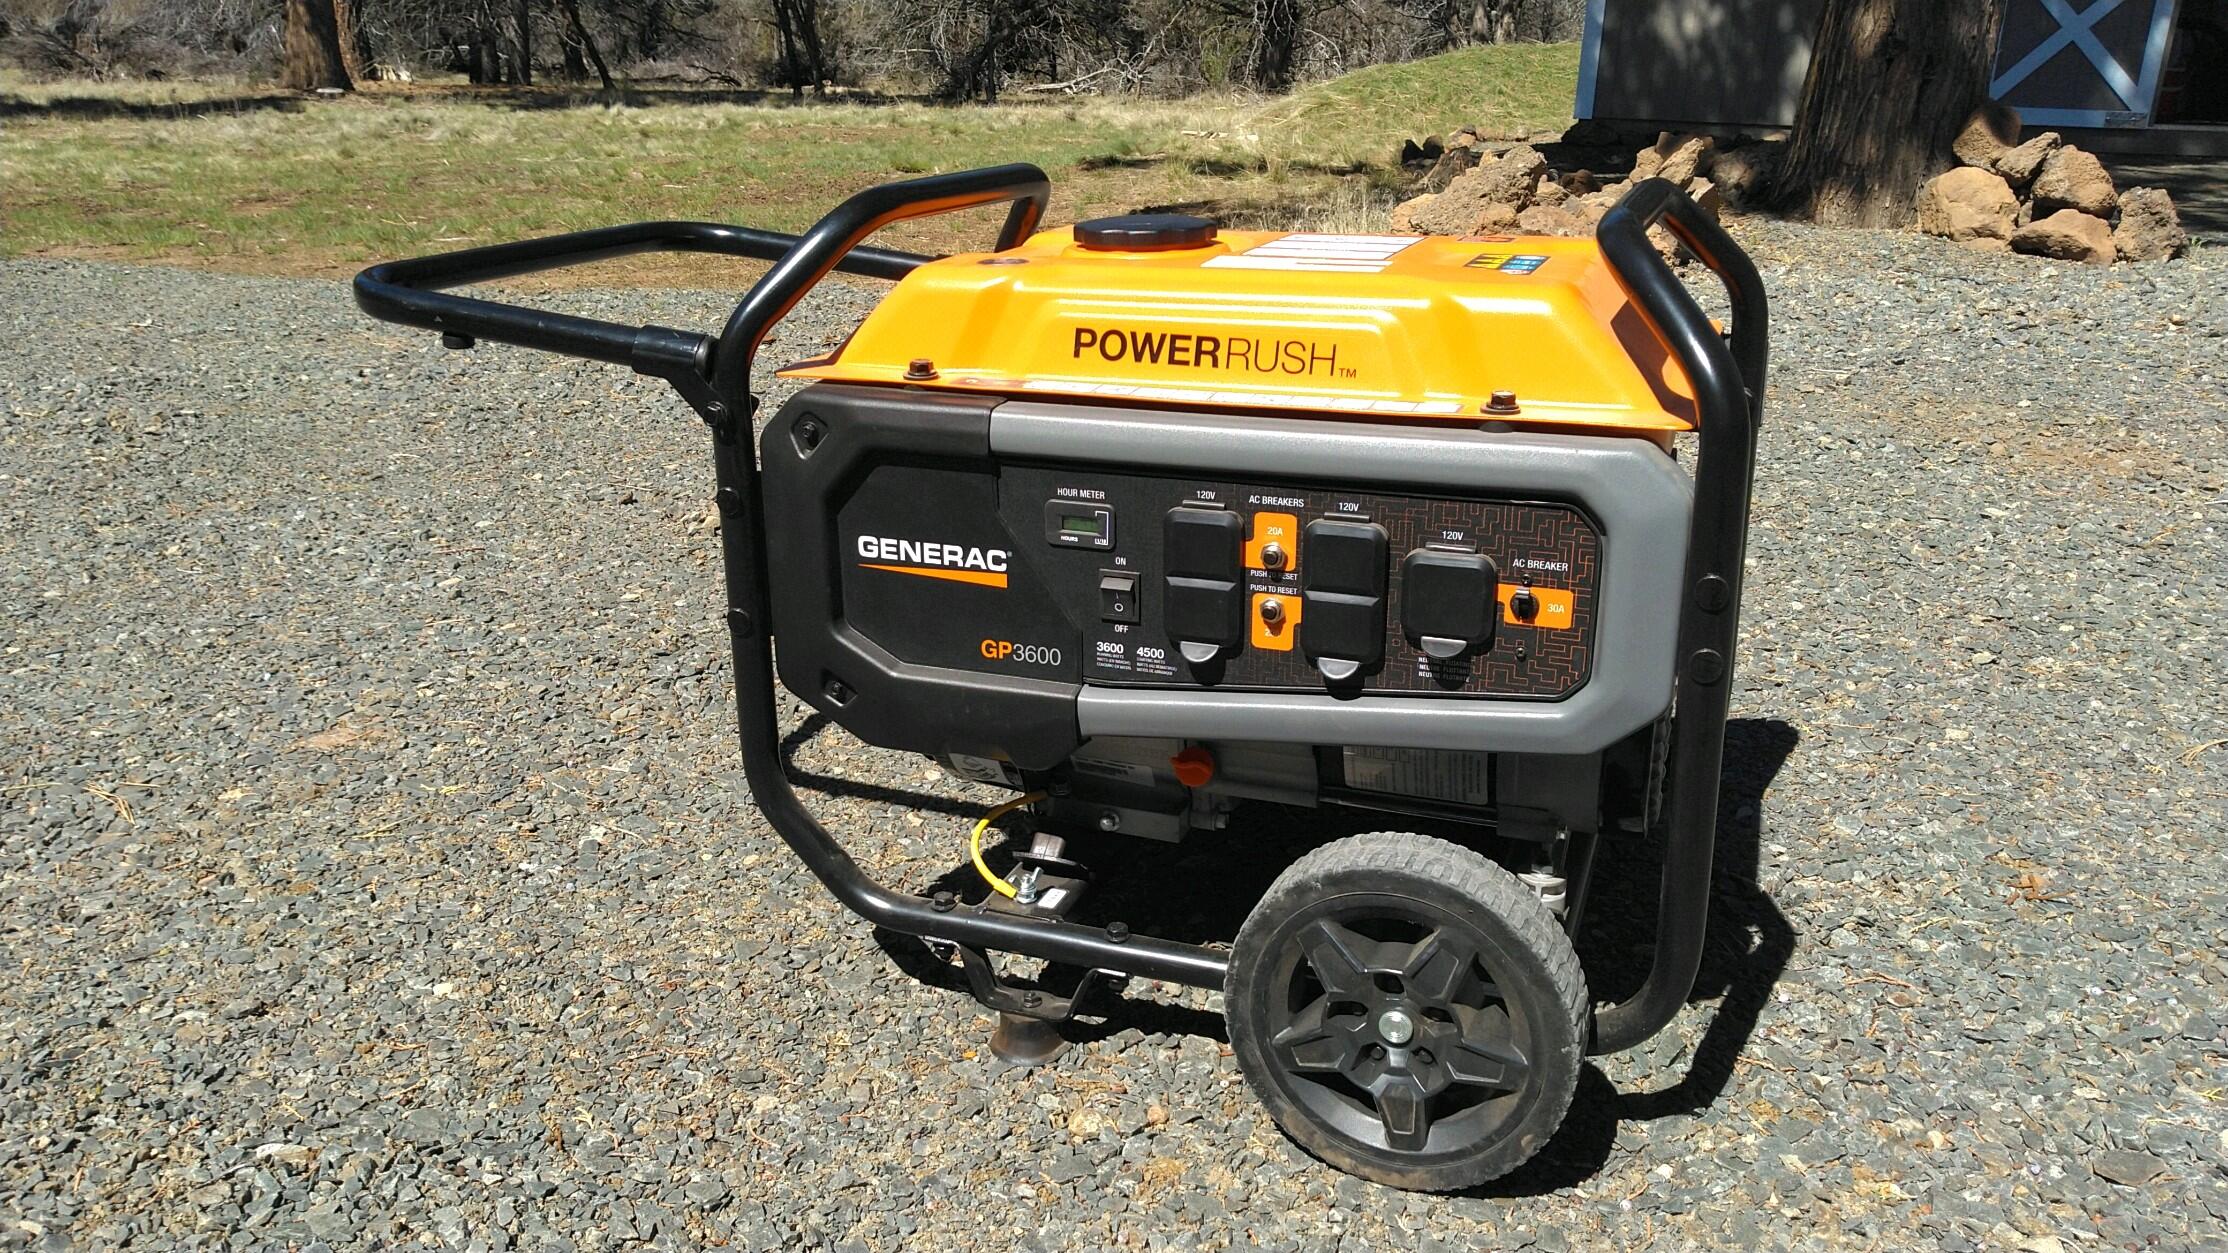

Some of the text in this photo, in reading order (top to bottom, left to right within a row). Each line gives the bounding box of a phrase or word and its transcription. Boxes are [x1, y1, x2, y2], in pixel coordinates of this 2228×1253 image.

[1057, 488, 1105, 500] HOUR METER
[1196, 490, 1216, 500] 120V
[1248, 495, 1305, 508] AC BREAKERS
[1338, 502, 1360, 512] 120V
[1267, 527, 1283, 537] 20A
[1442, 530, 1464, 541] 120V
[857, 535, 1008, 572] GENERAC
[1115, 556, 1127, 566] ON
[1512, 559, 1569, 572] AC BREAKER
[1250, 570, 1268, 578] PUSH
[1250, 584, 1298, 595] PUSH TO RESET
[1547, 603, 1565, 614] 30A
[1114, 624, 1129, 634] OFF
[980, 639, 1062, 666] GP3600
[1096, 641, 1124, 654] 3600
[1136, 646, 1165, 659] 4500
